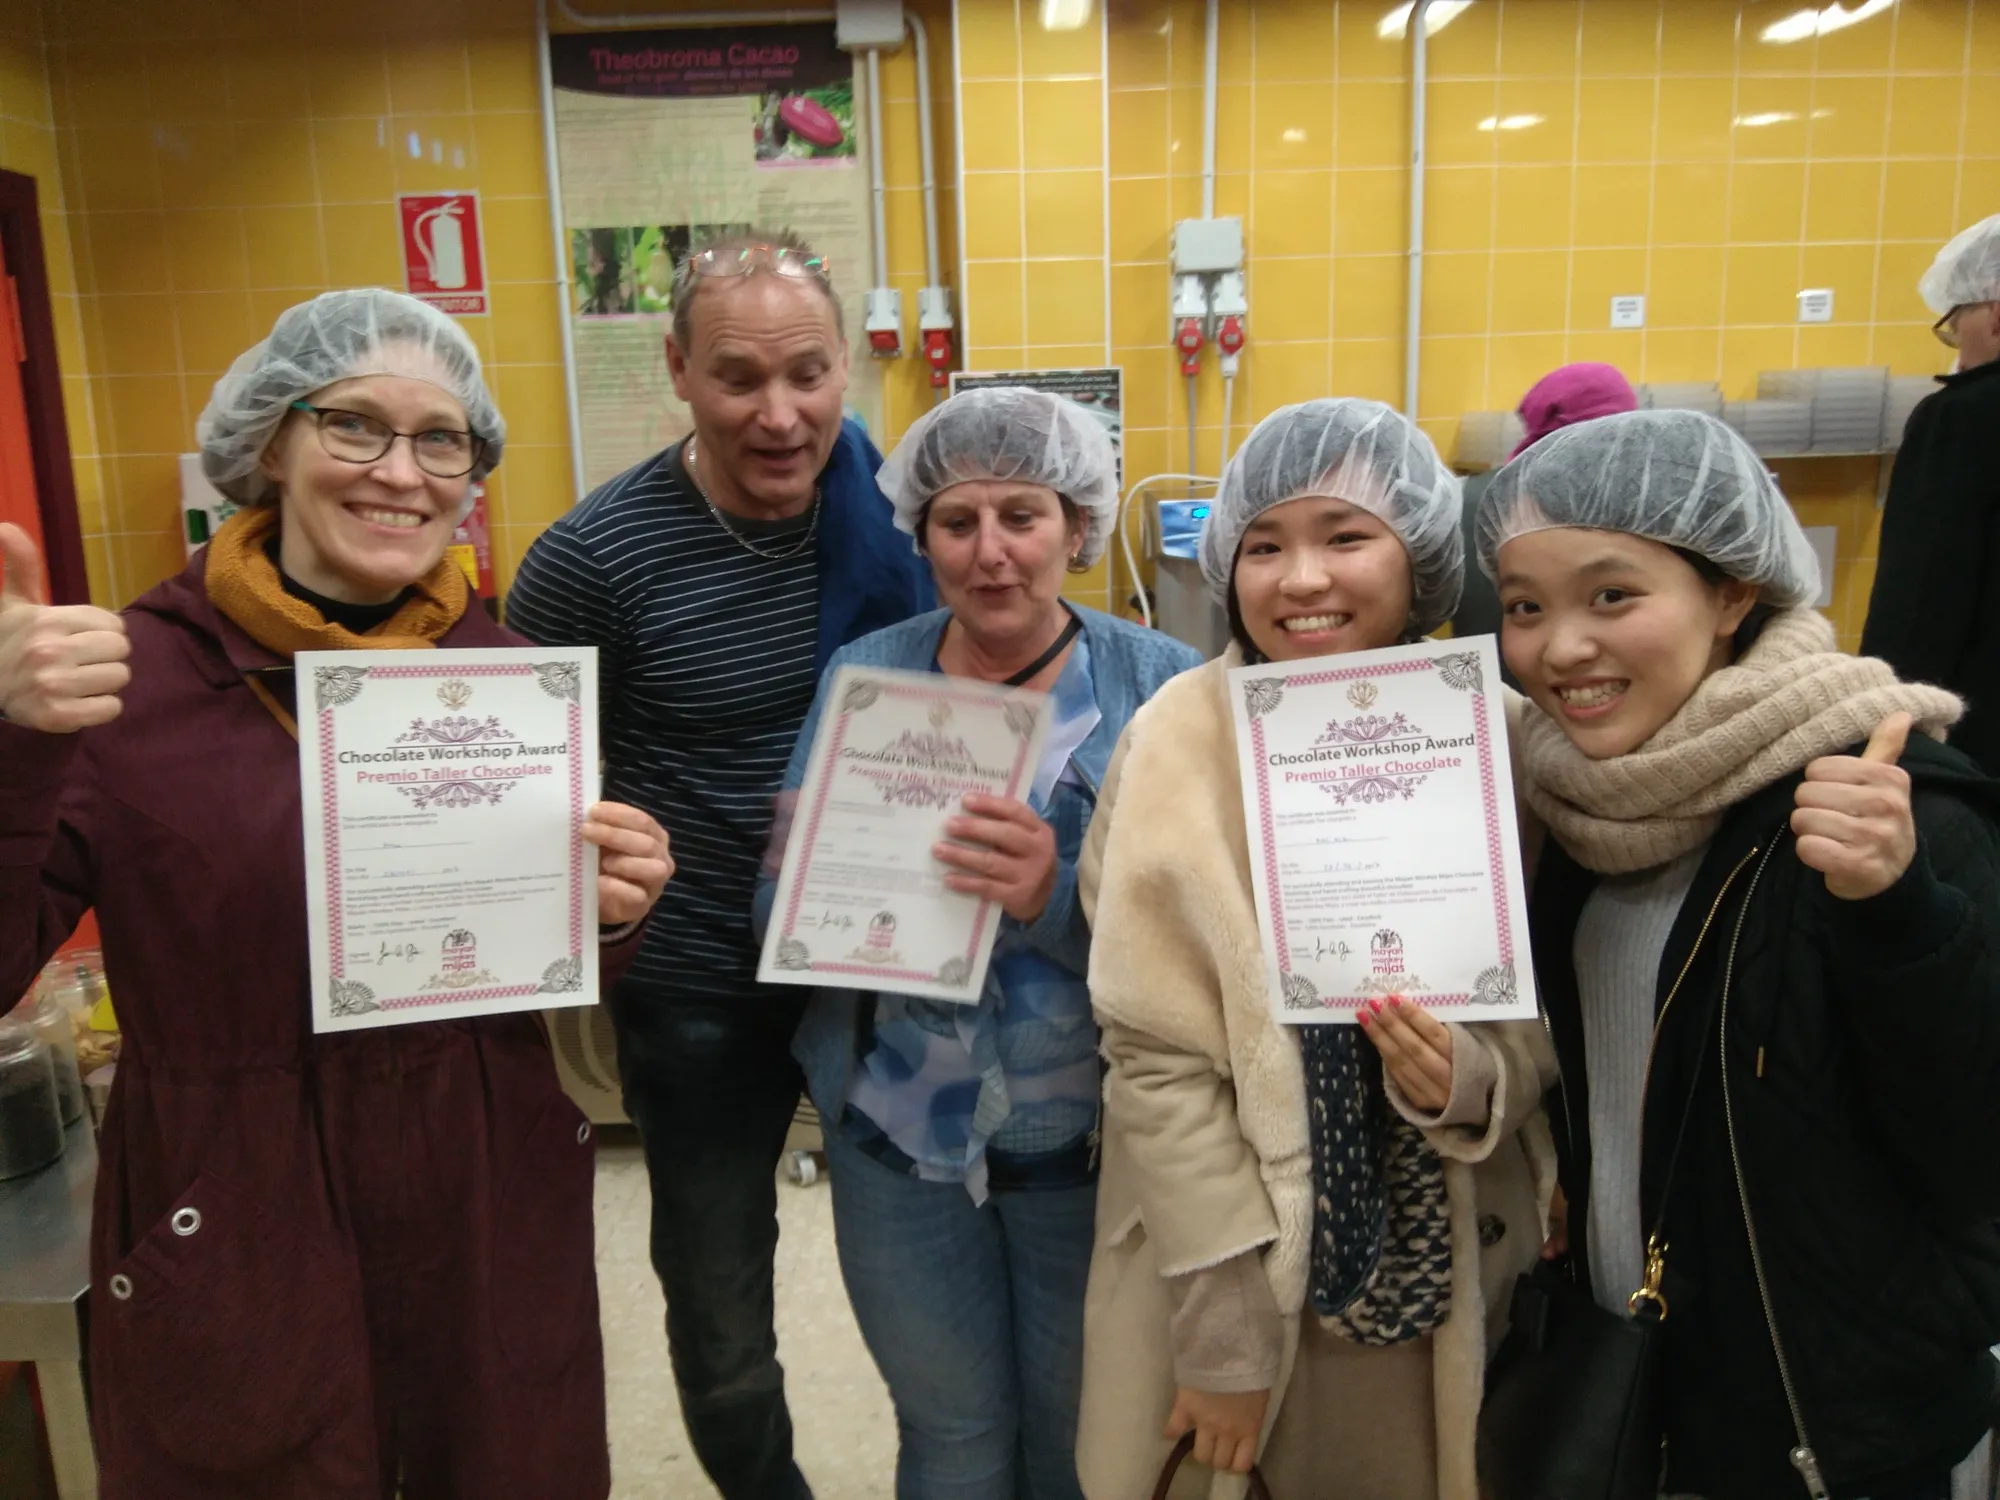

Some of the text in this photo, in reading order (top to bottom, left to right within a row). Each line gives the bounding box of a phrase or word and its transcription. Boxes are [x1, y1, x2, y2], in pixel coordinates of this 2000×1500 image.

[590, 42, 799, 71] Theobroma Cacao
[338, 742, 567, 765] Chocolate Workshop Award
[1269, 733, 1475, 767] Chocolate Workshop Award
[356, 762, 553, 784] Premio Taller Chocolate
[843, 746, 1010, 781] Chocolate Workshop Award
[1285, 755, 1462, 784] Premio Taller Chocolate
[848, 764, 894, 782] Premio
[896, 769, 929, 786] Taller
[1370, 947, 1404, 959] mayan
[442, 960, 477, 972] mijas
[1372, 962, 1406, 975] mijas
